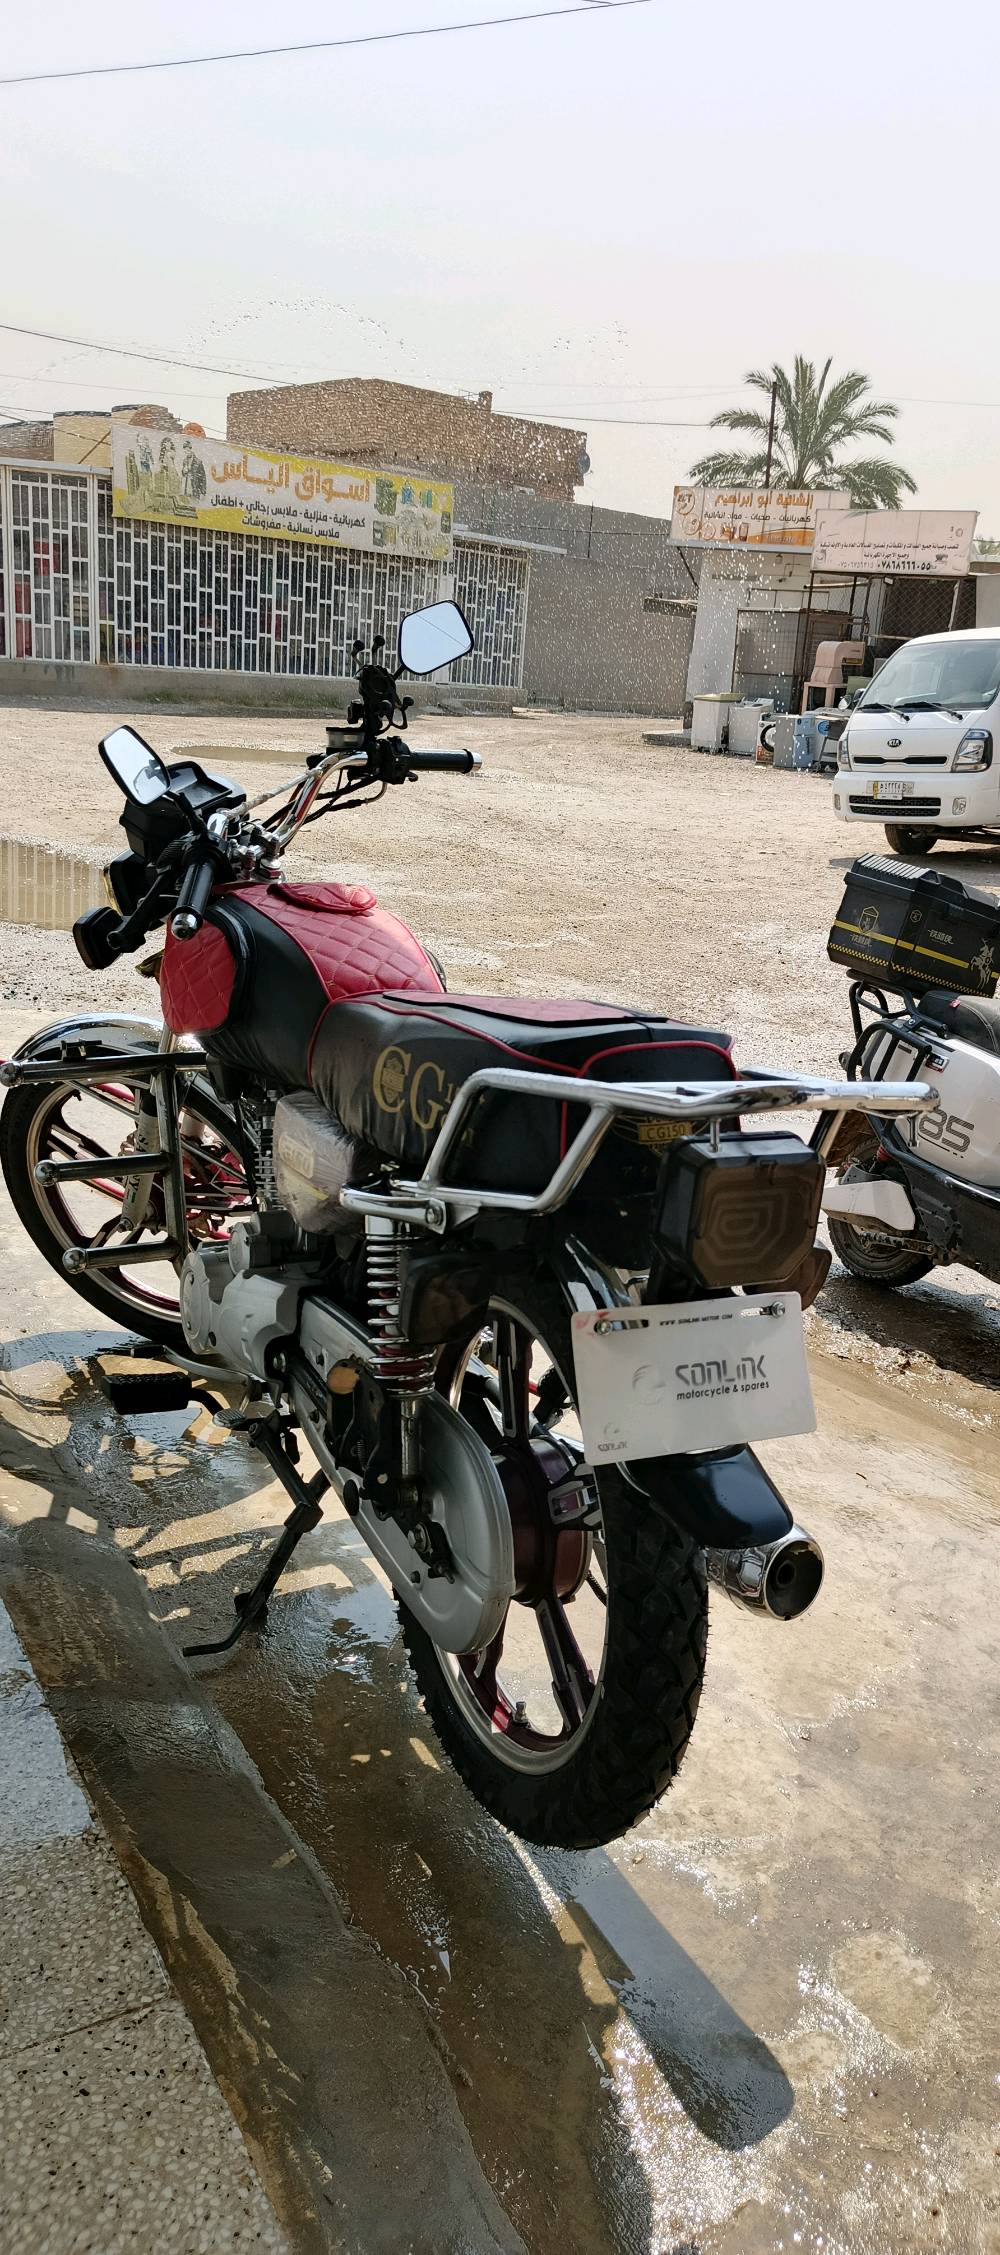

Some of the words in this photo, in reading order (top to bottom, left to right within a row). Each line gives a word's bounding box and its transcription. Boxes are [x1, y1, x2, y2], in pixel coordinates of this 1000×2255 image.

[210, 494, 238, 508] اطفال
[246, 500, 270, 515] رجالي
[271, 505, 298, 519] ملابس
[304, 510, 328, 522] منزلية
[241, 515, 282, 532] مفروشات
[287, 520, 313, 535] نسائية
[314, 525, 340, 539] ملابس
[888, 739, 901, 747] KIA
[646, 1123, 686, 1140] CG150
[676, 1385, 731, 1401] motorcycle
[732, 1384, 740, 1393] &
[740, 1381, 770, 1394] spares
